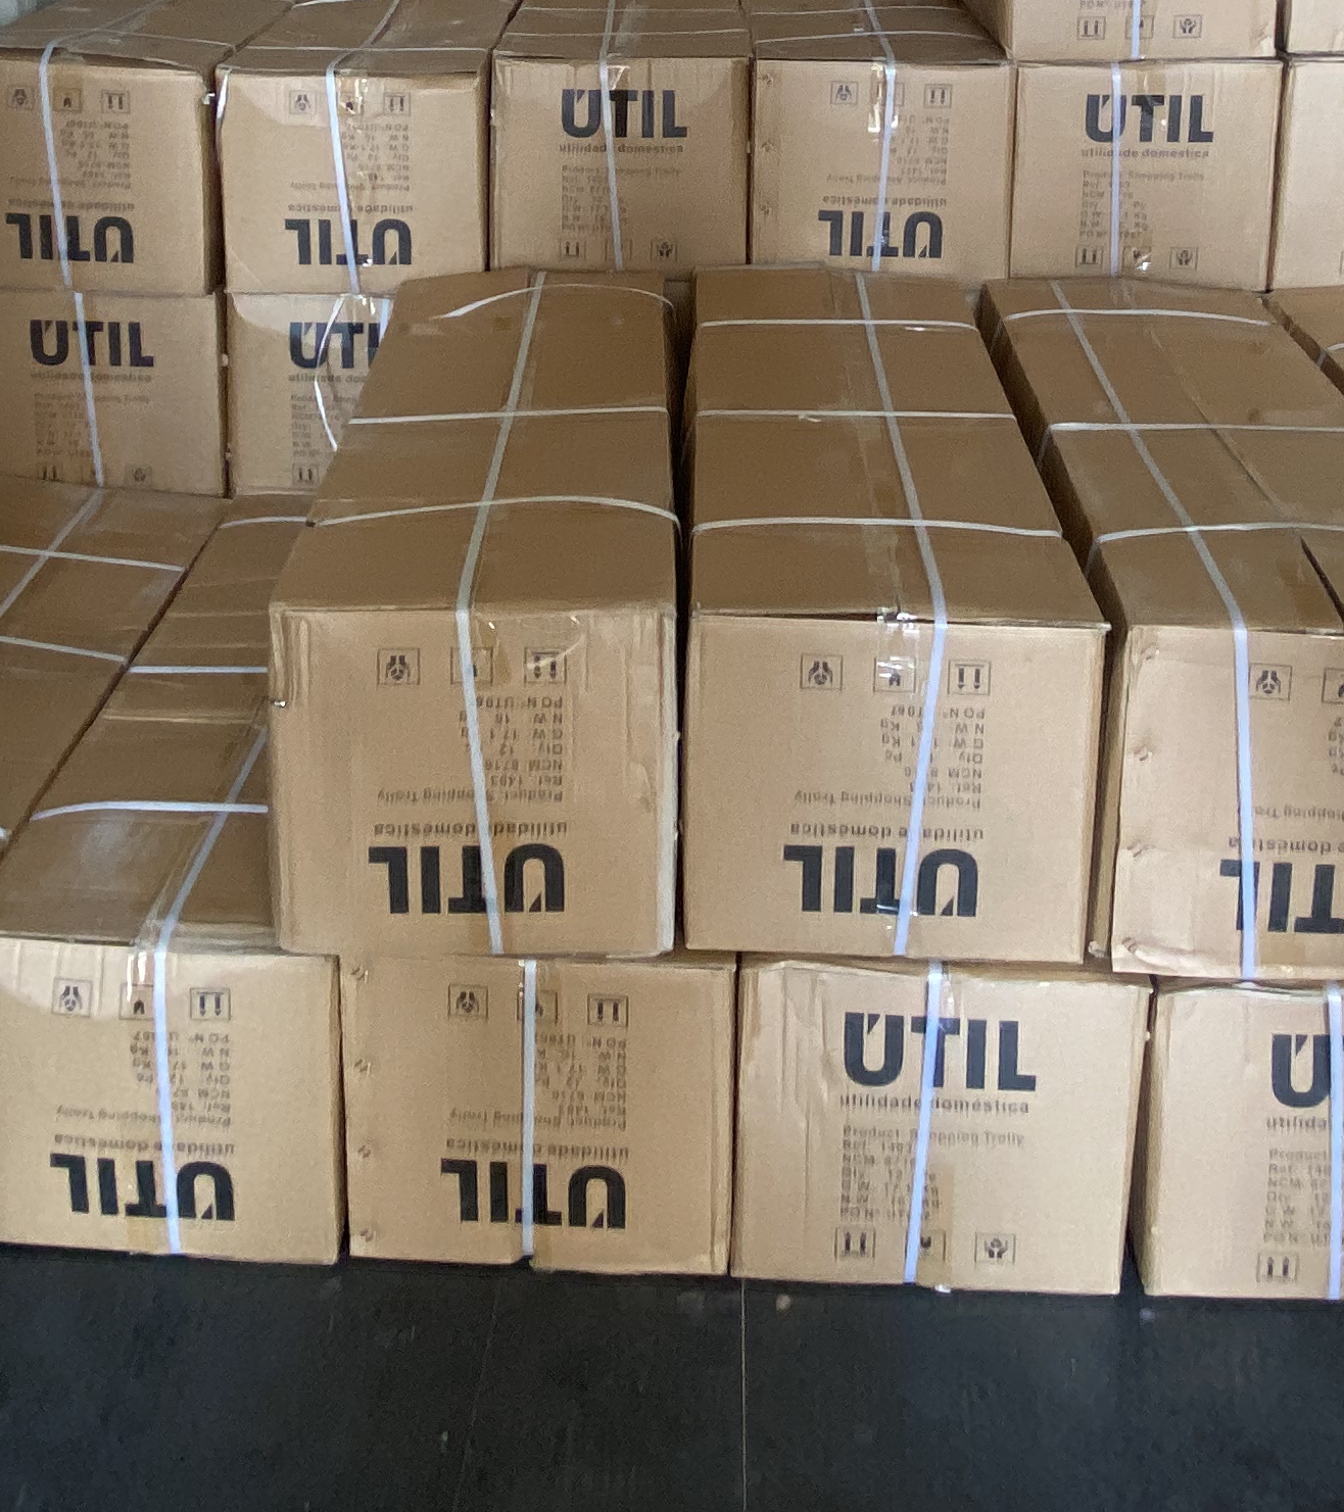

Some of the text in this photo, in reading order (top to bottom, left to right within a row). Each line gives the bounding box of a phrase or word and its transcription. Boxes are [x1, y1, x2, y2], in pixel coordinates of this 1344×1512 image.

[289, 321, 381, 370] ÚTI
[489, 821, 568, 839] utilidad
[898, 827, 985, 843] utilidae
